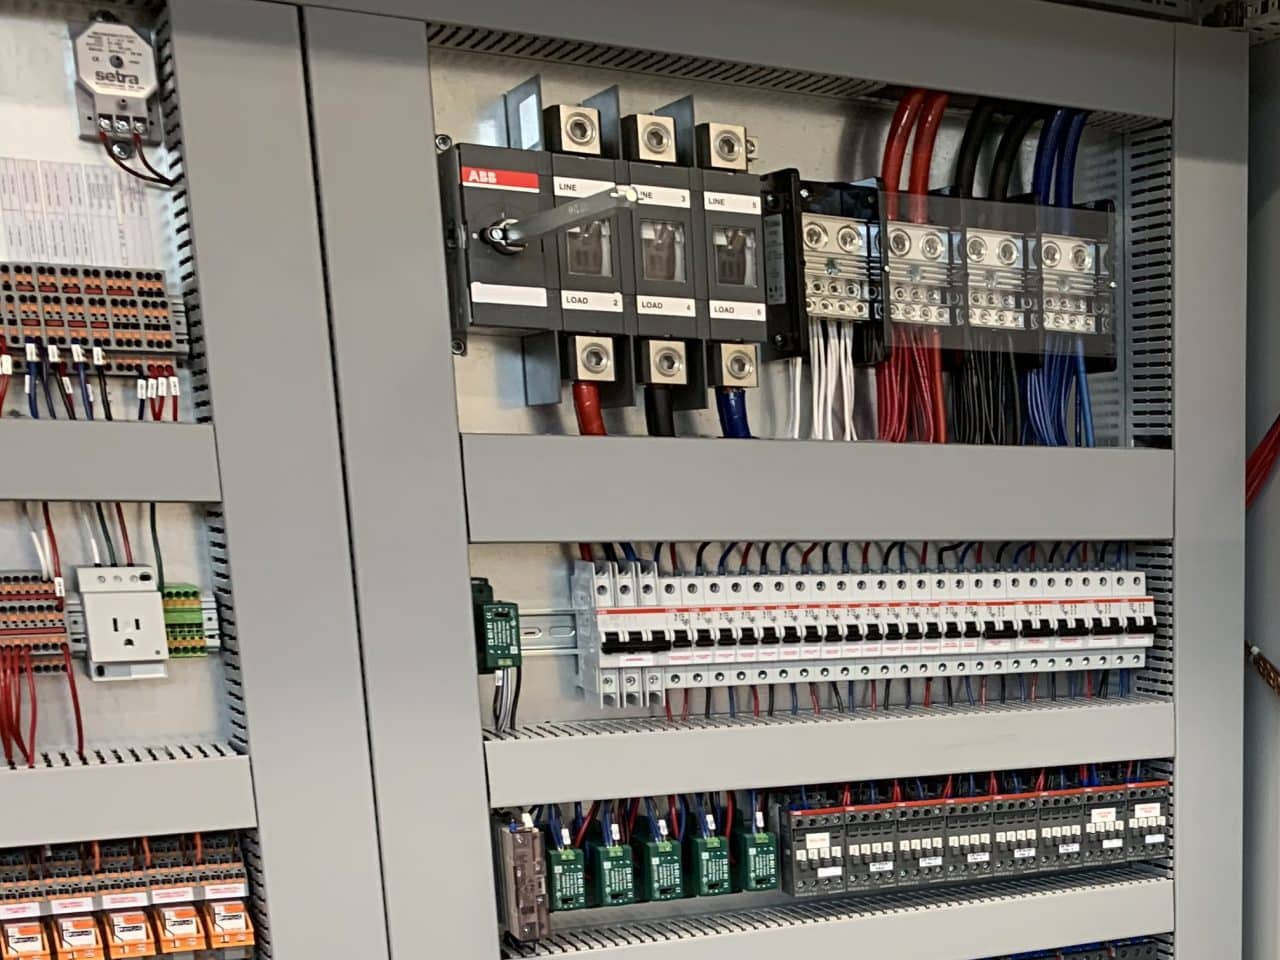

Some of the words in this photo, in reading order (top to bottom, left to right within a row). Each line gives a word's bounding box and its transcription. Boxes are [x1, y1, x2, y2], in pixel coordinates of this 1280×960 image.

[95, 70, 139, 85] setra
[468, 169, 497, 184] ABB
[559, 183, 577, 192] LINE
[708, 197, 725, 206] LINE
[566, 296, 589, 305] LOAD
[613, 299, 618, 307] 2
[641, 301, 663, 310] LOAD
[714, 305, 735, 314] LOAD
